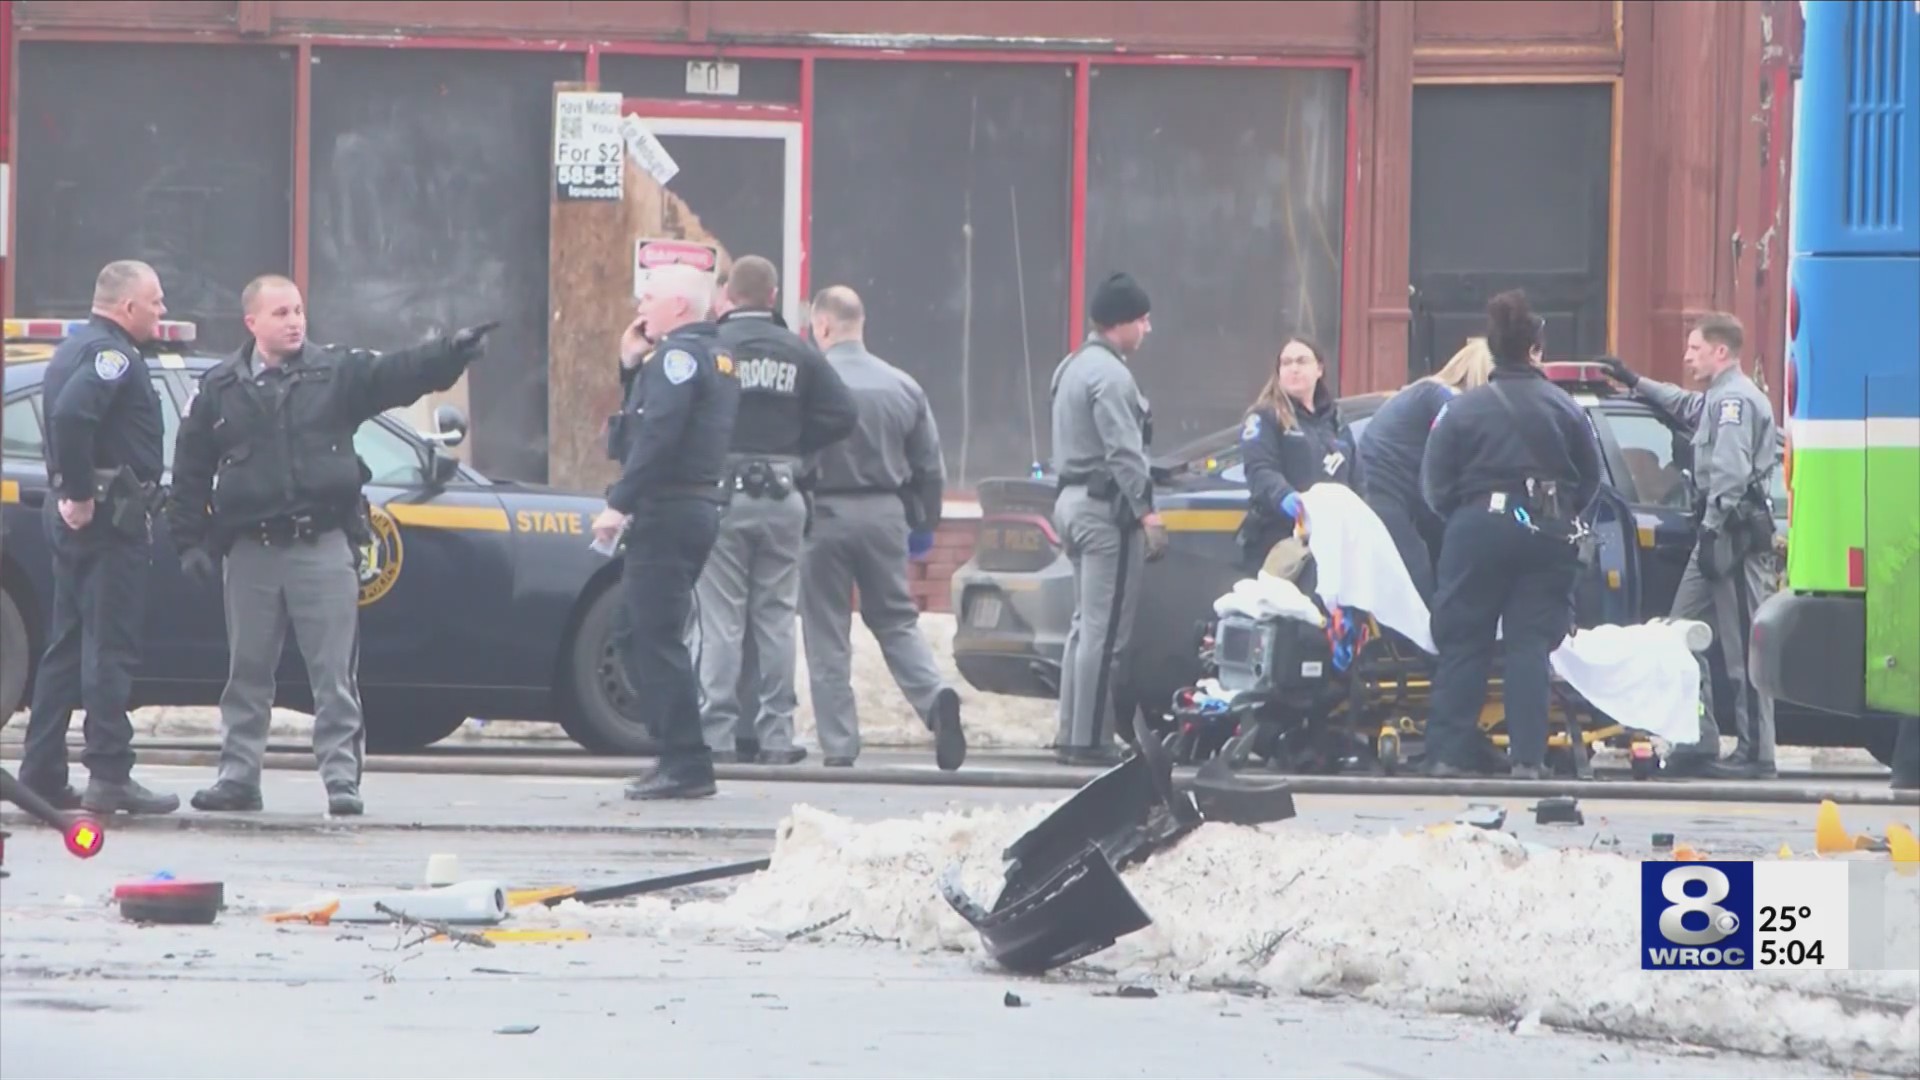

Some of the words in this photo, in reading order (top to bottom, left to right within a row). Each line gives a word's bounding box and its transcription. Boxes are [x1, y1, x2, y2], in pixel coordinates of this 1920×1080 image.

[559, 142, 590, 162] For
[598, 142, 620, 163] $2
[516, 511, 583, 534] STATE
